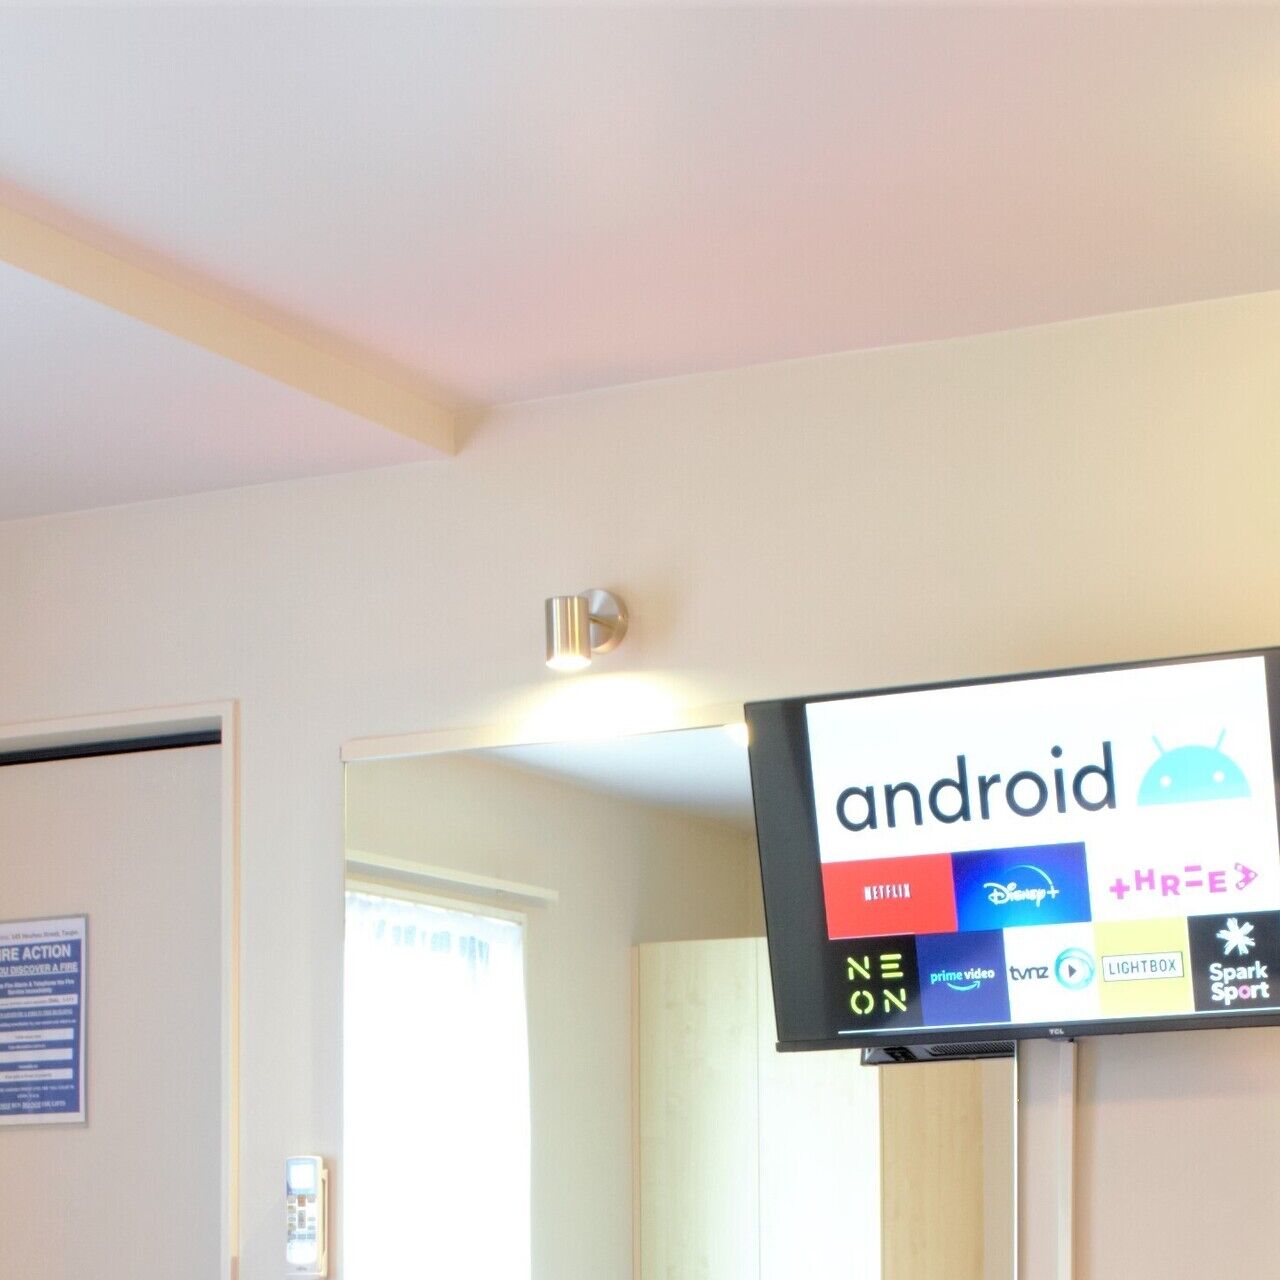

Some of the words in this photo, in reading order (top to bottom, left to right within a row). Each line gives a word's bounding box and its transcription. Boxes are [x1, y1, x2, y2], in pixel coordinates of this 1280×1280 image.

[836, 741, 1116, 832] android
[864, 883, 911, 901] NETFLIX
[22, 944, 71, 960] ACTION
[1010, 965, 1049, 980] tvnz
[1109, 959, 1177, 975] LIGHTBOX
[1209, 960, 1269, 984] Spark
[930, 970, 963, 984] prime
[964, 968, 995, 980] video
[1211, 981, 1270, 1006] Sport
